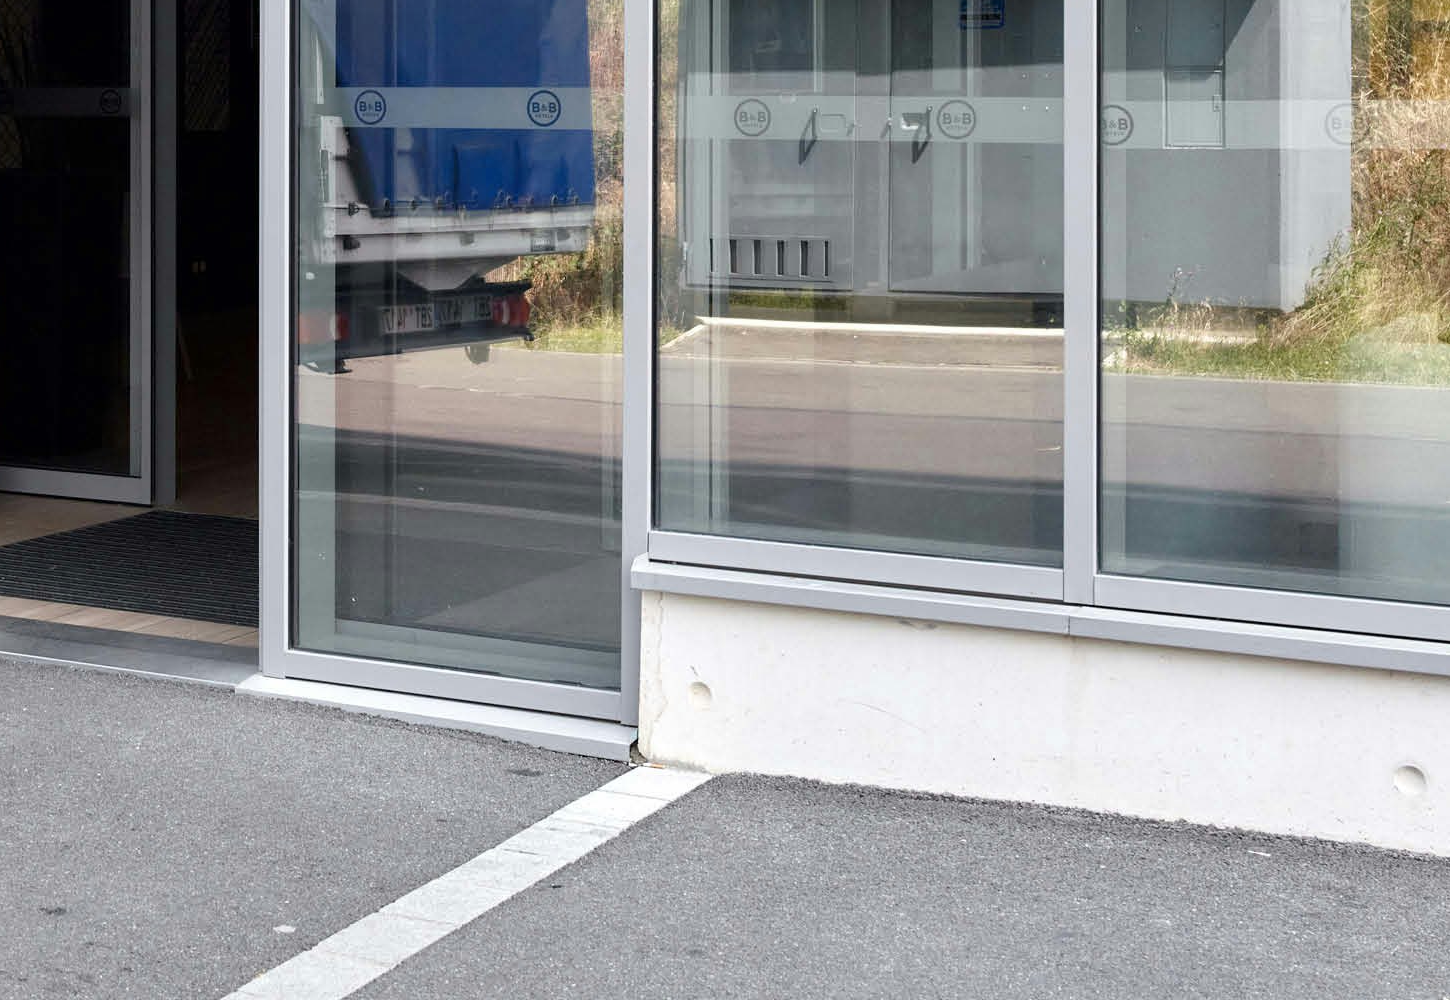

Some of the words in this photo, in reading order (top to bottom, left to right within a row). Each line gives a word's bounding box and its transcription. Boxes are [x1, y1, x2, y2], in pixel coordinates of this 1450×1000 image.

[359, 101, 383, 112] B&B
[532, 101, 558, 113] B&B
[738, 111, 767, 123] B&B
[941, 112, 972, 125] B&B
